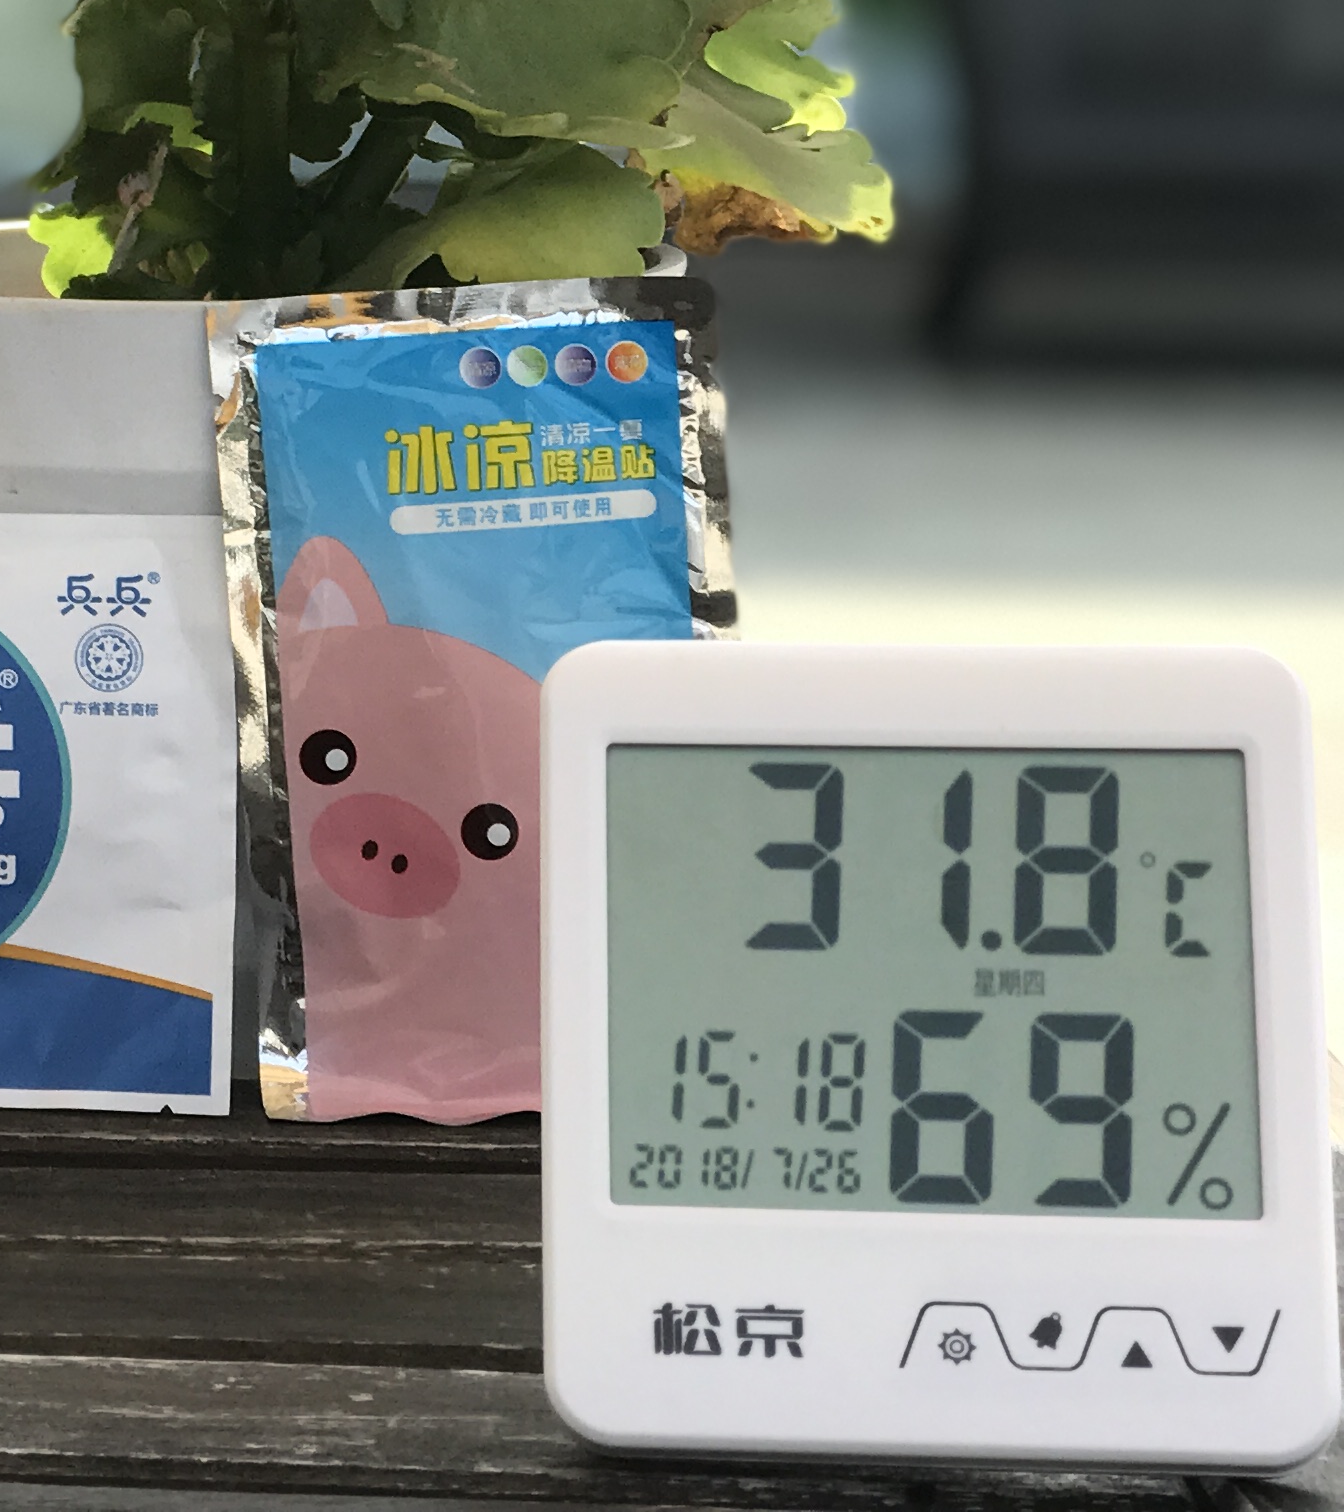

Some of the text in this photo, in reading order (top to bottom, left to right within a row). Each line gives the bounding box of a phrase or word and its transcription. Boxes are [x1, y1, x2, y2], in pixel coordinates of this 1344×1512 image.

[384, 420, 535, 494] 冰凉
[542, 443, 656, 485] 降温贴
[59, 701, 159, 717] 广东省著名商标
[745, 762, 1119, 956] 31.8
[671, 1031, 866, 1132] 15:18
[889, 1010, 1134, 1208] 69
[653, 1303, 804, 1359] 松京
